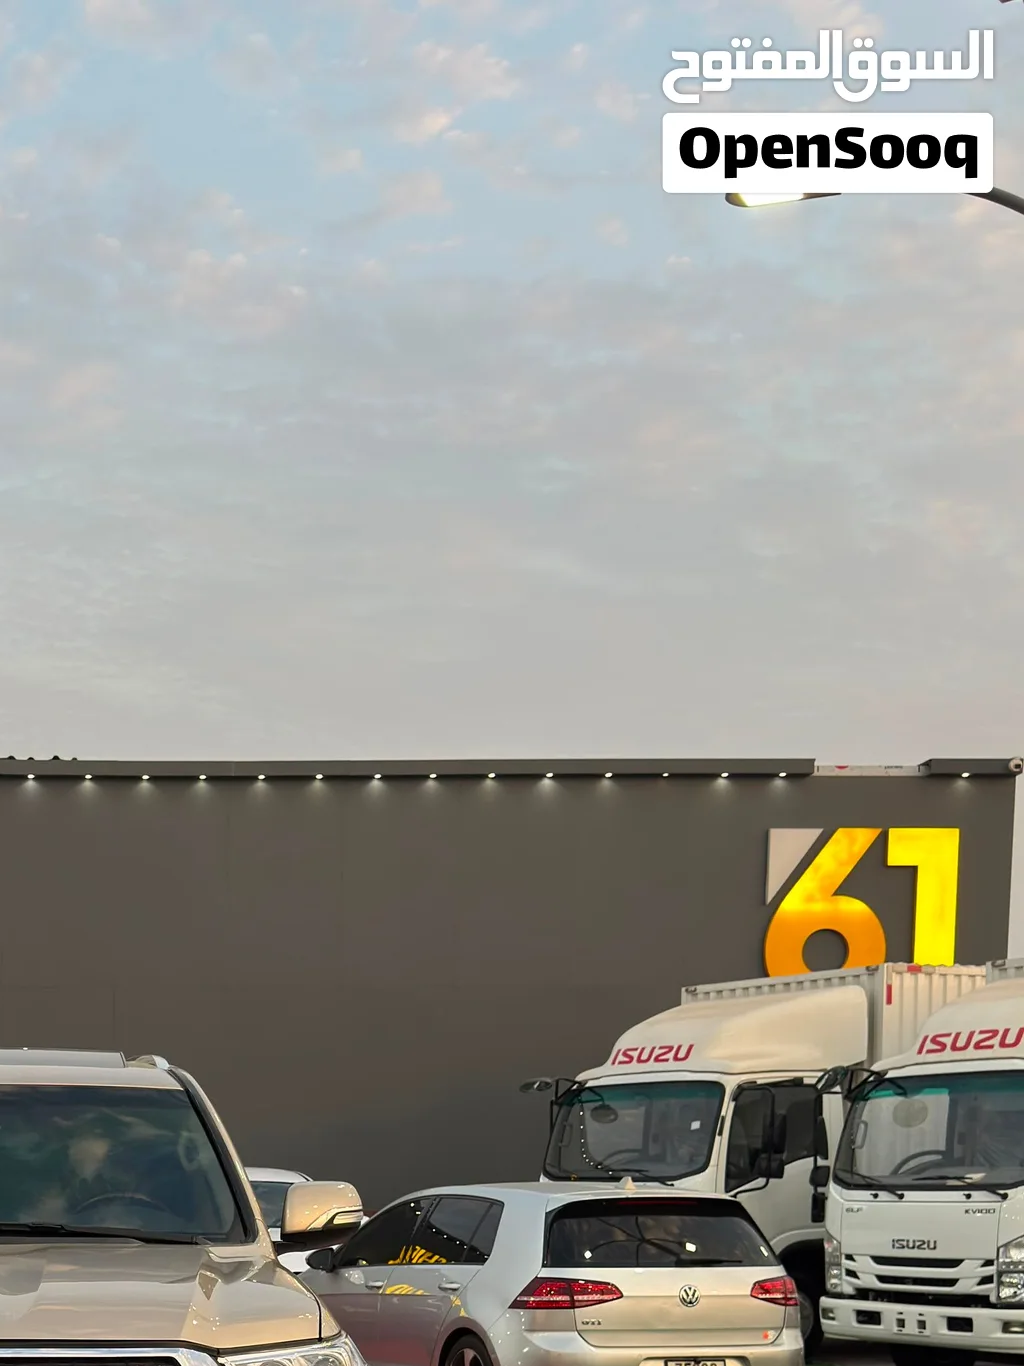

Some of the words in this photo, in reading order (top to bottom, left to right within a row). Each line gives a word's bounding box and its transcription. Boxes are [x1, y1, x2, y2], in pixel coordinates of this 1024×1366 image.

[764, 827, 960, 977] 61
[916, 1027, 1024, 1056] ISUZU
[611, 1043, 695, 1066] ISUZU
[964, 1207, 996, 1215] KV100
[891, 1238, 938, 1251] ISUZU
